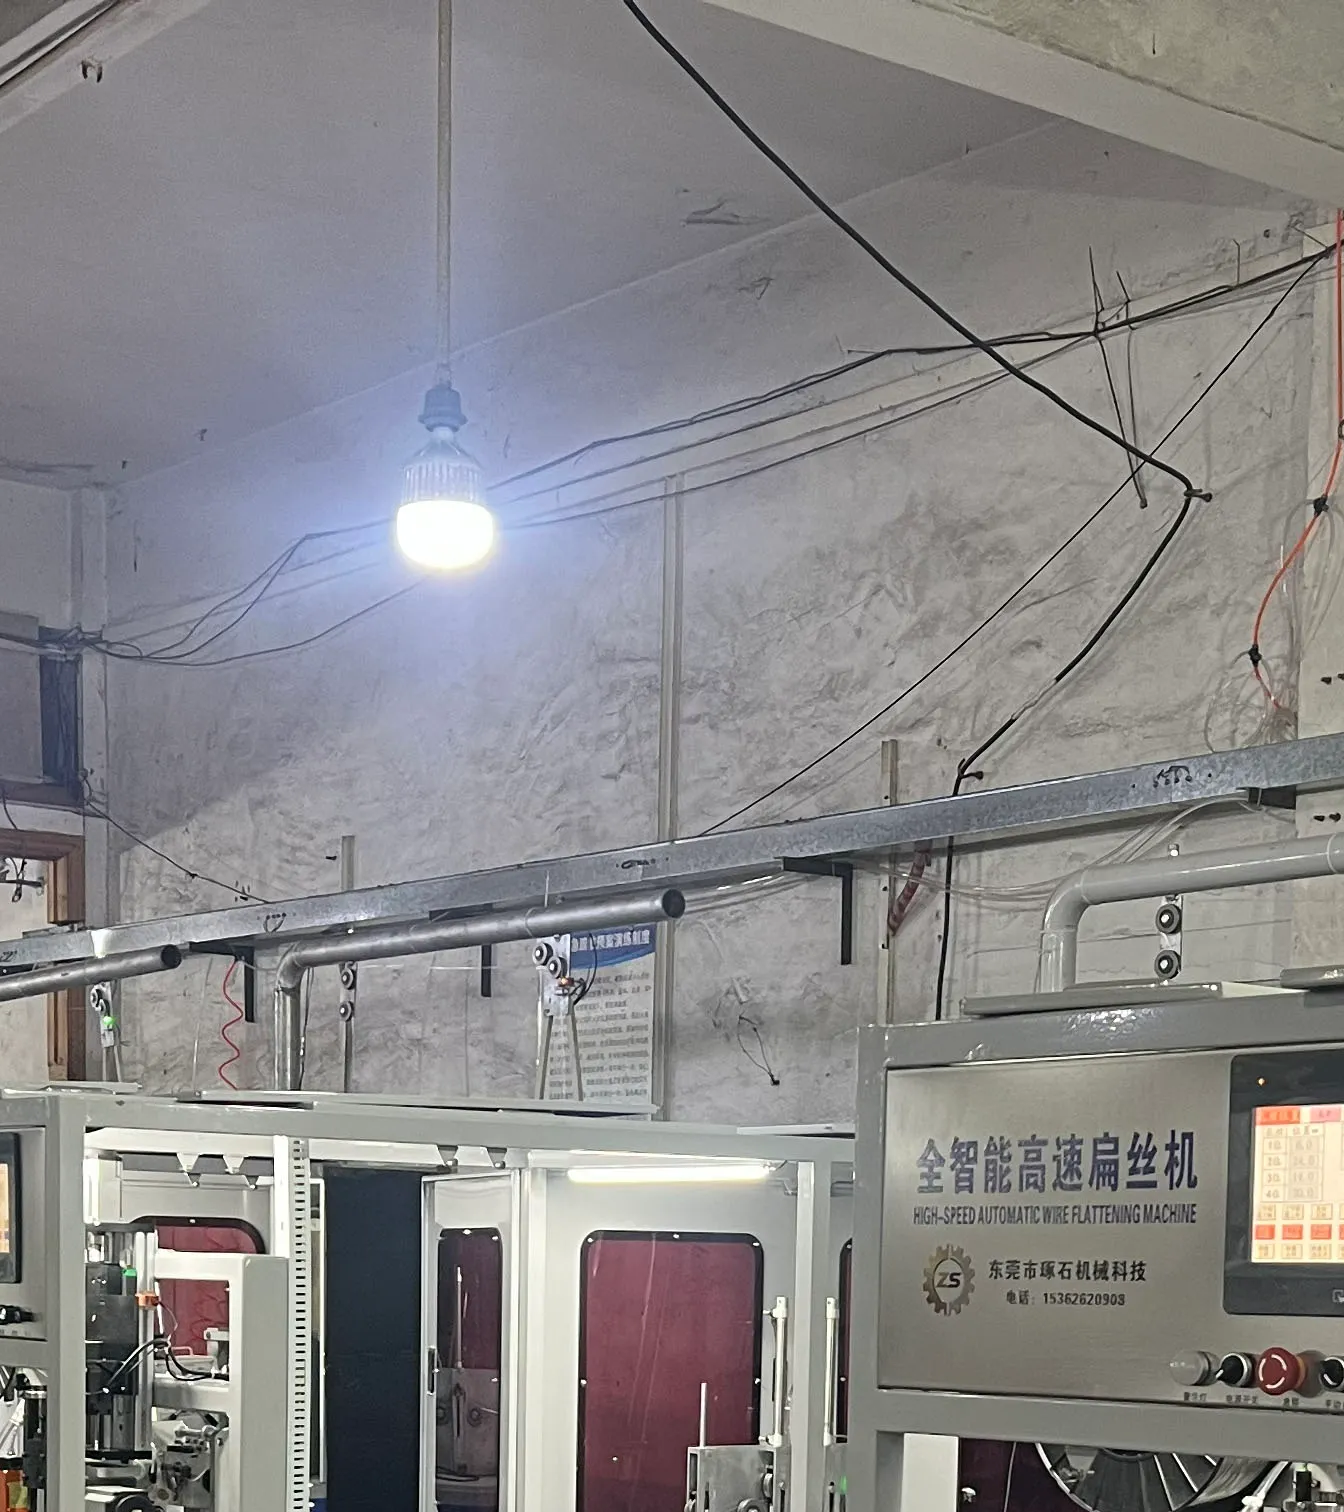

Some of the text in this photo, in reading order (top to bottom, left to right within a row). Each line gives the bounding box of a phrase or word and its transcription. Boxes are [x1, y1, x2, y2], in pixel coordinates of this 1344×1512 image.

[916, 1129, 1198, 1194] 全智能高速扁丝机
[913, 1203, 1197, 1226] HIGH-SPEED AUTOMATIC WIRE FLATTENING MACHINE
[988, 1259, 1147, 1283] 东莞市琢石机械科技
